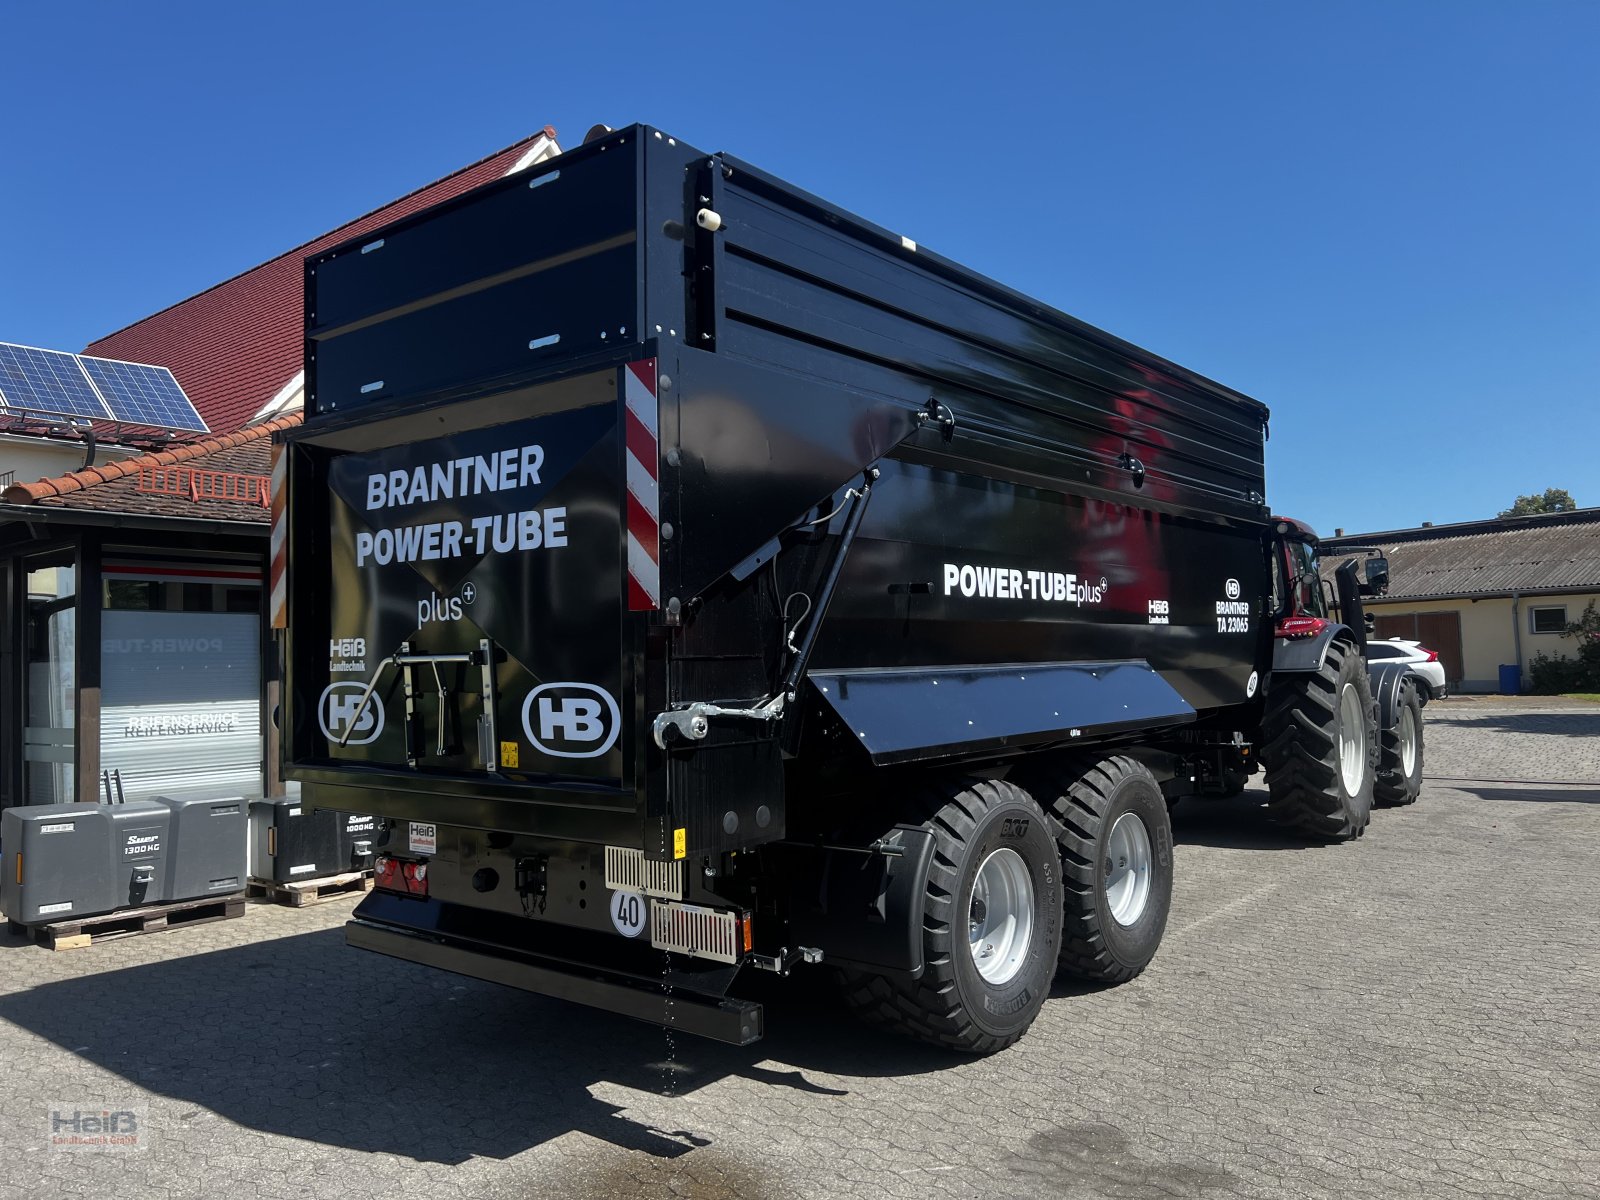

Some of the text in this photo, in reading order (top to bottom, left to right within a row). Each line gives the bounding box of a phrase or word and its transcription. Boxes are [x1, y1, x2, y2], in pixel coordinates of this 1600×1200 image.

[366, 444, 544, 511] BRANTNER
[356, 507, 568, 567] POWER-TUBE
[1215, 601, 1249, 615] BRANTNER
[1217, 618, 1249, 633] TA 23065
[128, 712, 240, 730] REIFENSERVICE
[538, 697, 605, 742] HB
[346, 824, 363, 832] 1000
[411, 824, 435, 837] Heiß
[127, 836, 159, 845] Suer
[125, 845, 146, 855] 1300
[617, 895, 639, 928] 40
